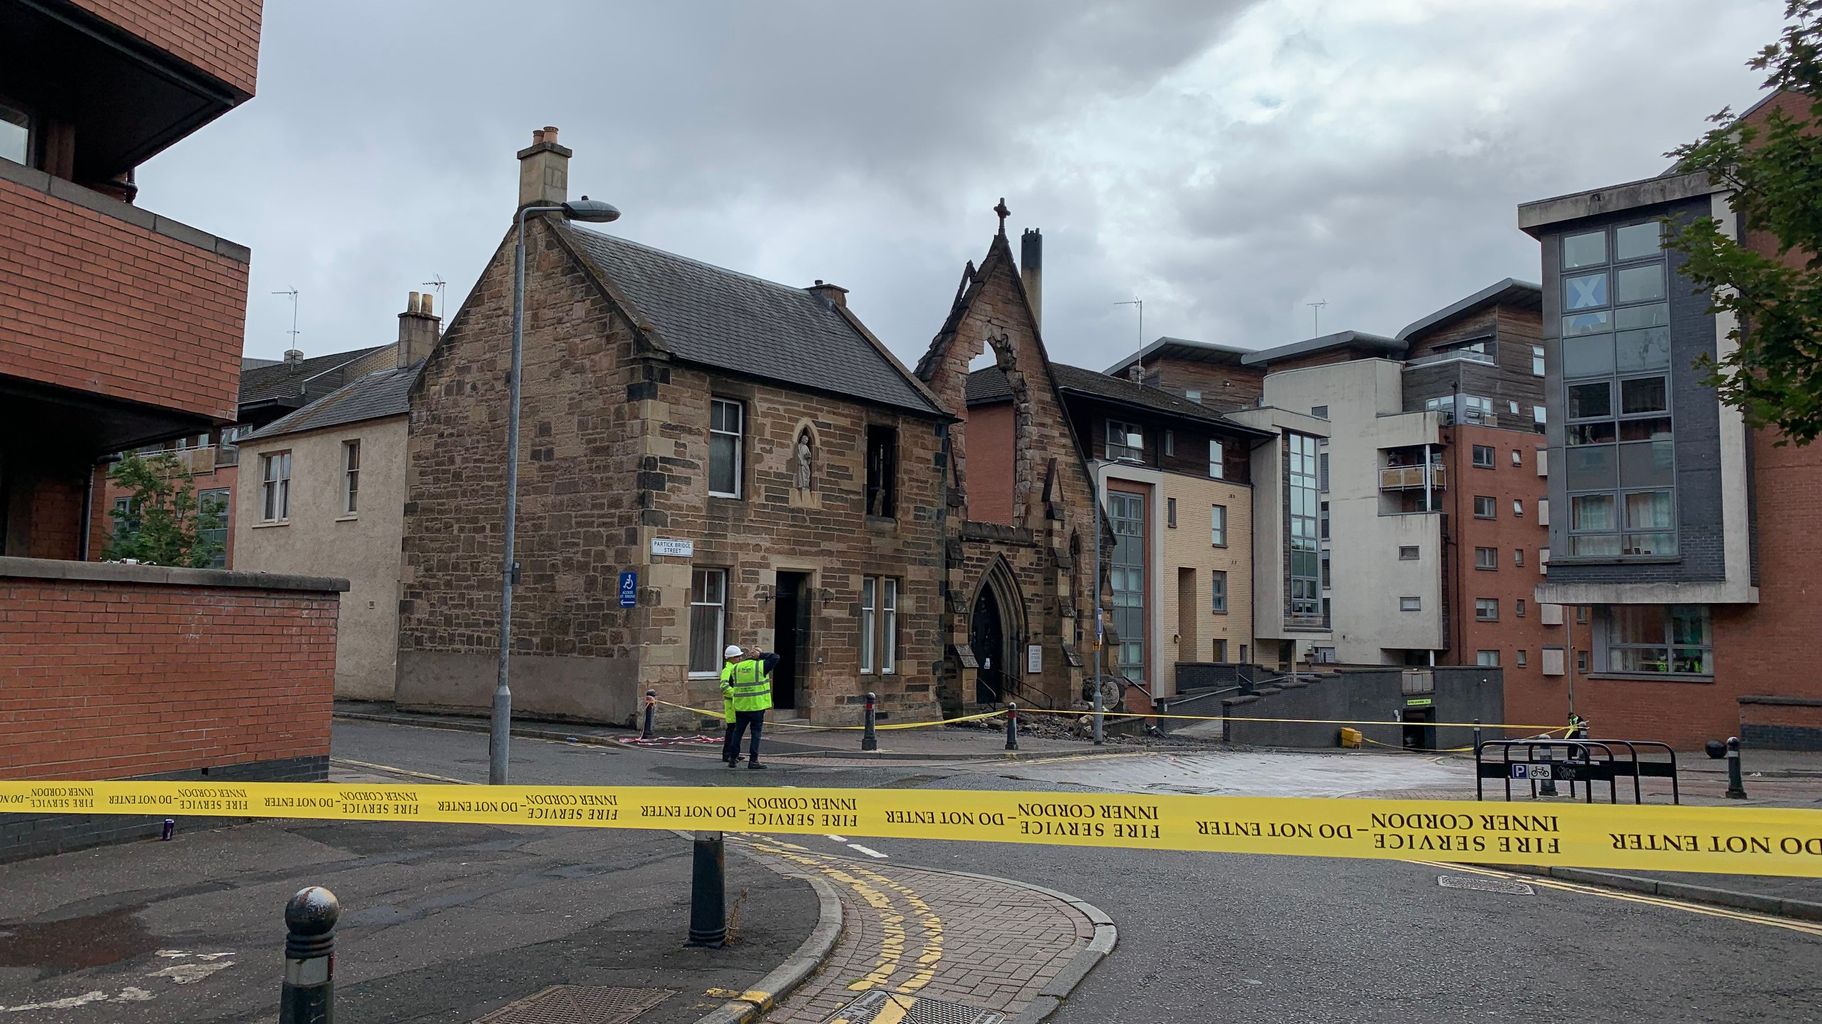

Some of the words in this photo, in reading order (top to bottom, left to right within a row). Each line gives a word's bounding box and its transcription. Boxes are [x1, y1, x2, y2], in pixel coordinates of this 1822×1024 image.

[1515, 765, 1525, 777] P
[31, 787, 67, 797] CORDON
[68, 787, 94, 797] INNER
[178, 788, 217, 798] CORDON
[218, 788, 248, 798] INNER
[339, 791, 384, 802] CORDON
[384, 791, 419, 802] INNER
[11, 794, 24, 804] DO
[31, 798, 70, 808] SERVICE
[73, 798, 94, 808] FIRE
[109, 794, 137, 805] ENTER
[138, 794, 157, 805] NOT
[159, 794, 173, 805] DO
[180, 799, 222, 810] SERVICE
[224, 800, 249, 810] FIRE
[264, 797, 295, 808] ENTER
[295, 798, 317, 808] NOT
[318, 798, 334, 808] DO
[526, 793, 577, 806] CORDON
[579, 794, 619, 806] INNER
[747, 797, 809, 810] CORDON
[811, 798, 858, 811] INNER
[342, 803, 390, 814] SERVICE
[392, 803, 419, 815] FIRE
[437, 800, 473, 812] ENTER
[474, 801, 499, 813] NOT
[501, 801, 519, 813] DO
[641, 805, 682, 818] ENTER
[684, 806, 713, 818] NOT
[715, 806, 737, 819] DO
[1018, 803, 1096, 819] CORDON
[527, 807, 585, 820] SERVICE
[587, 808, 619, 821] FIRE
[748, 812, 815, 827] SERVICE
[885, 810, 936, 825] ENTER
[939, 811, 976, 826] NOT
[979, 812, 1006, 827] DO
[1099, 805, 1160, 821] INNER
[822, 813, 858, 828] FIRE
[1370, 812, 1474, 831] CORDON
[1479, 814, 1561, 833] INNER
[1020, 820, 1105, 838] SERVICE
[1113, 824, 1161, 839] FIRE
[1195, 820, 1264, 837] ENTER
[1266, 822, 1315, 840] NOT
[1319, 823, 1354, 840] DO
[1373, 833, 1486, 852] SERVICE
[1497, 836, 1562, 855] FIRE
[1608, 832, 1701, 852] ENTER
[1708, 835, 1773, 854] NOT
[1779, 837, 1822, 856] DO
